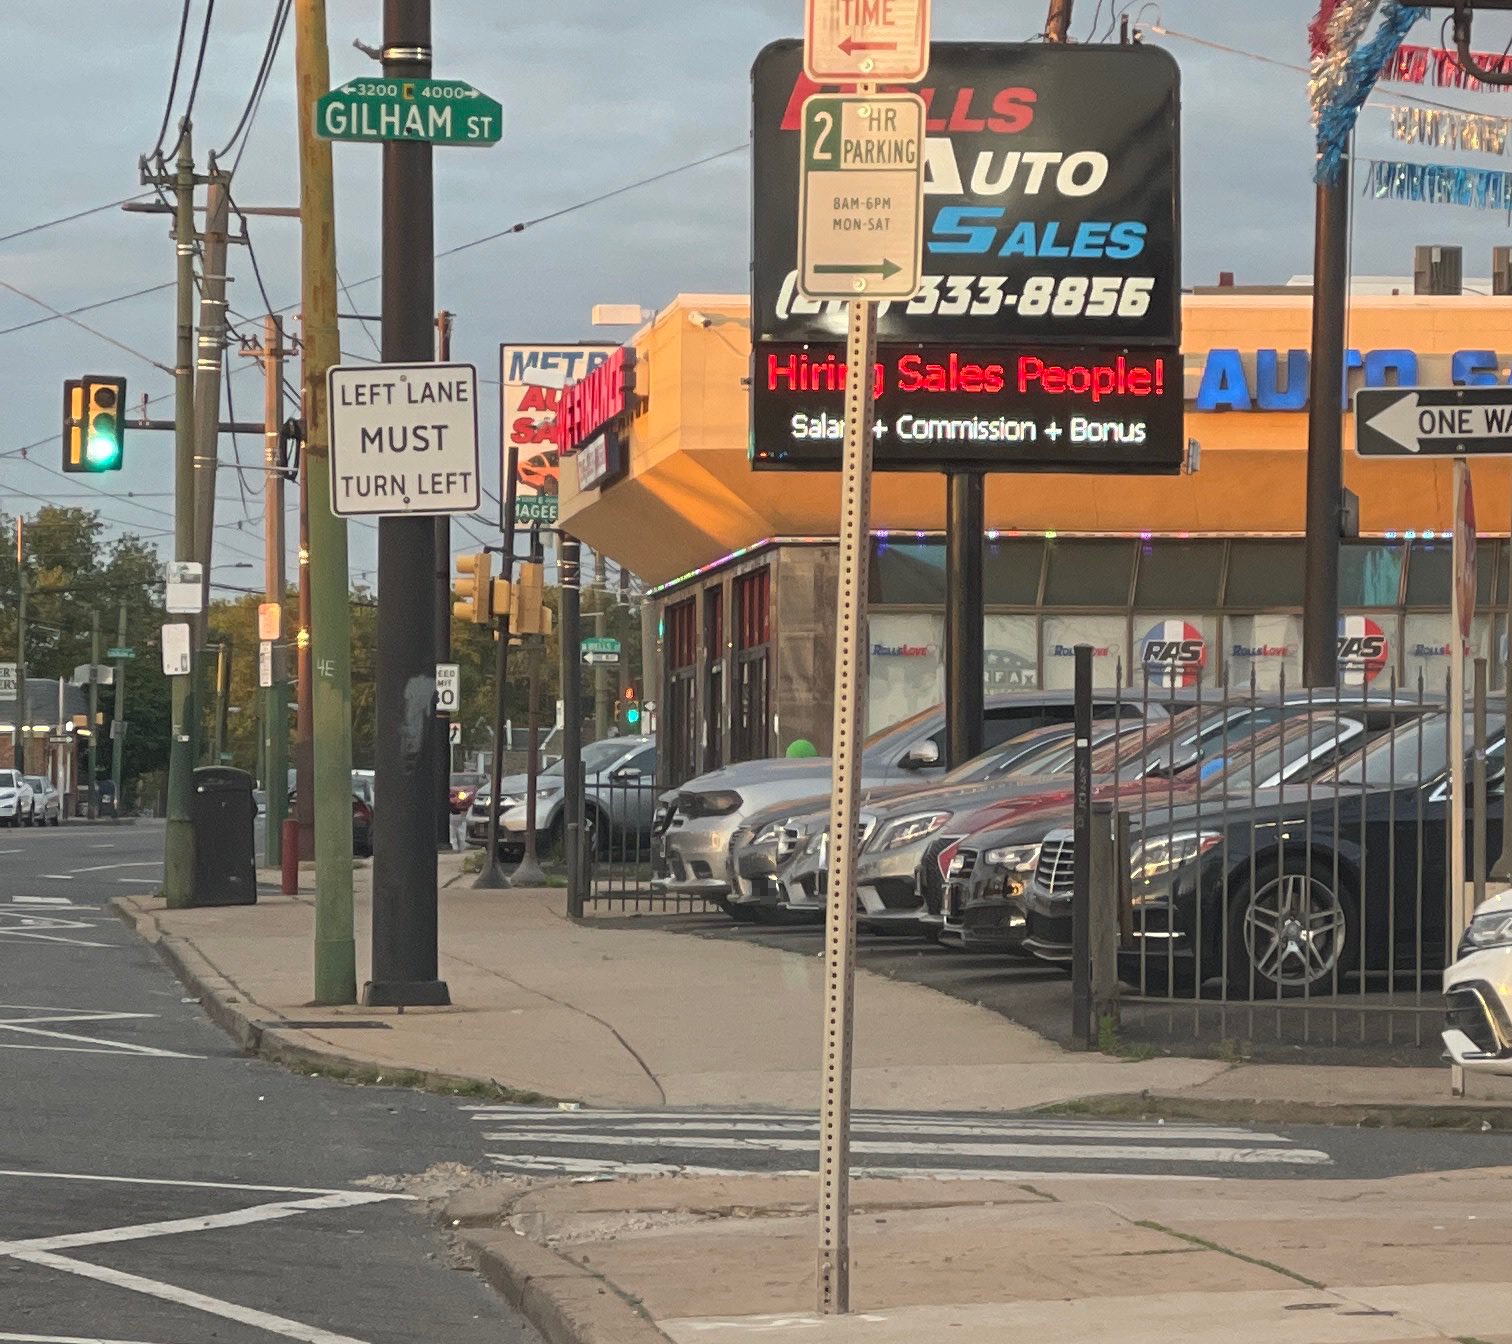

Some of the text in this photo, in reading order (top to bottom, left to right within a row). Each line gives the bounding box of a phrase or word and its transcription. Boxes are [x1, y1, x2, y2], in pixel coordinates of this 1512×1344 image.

[356, 83, 398, 97] 3200
[421, 86, 465, 99] 4000
[325, 101, 493, 138] GILHAM ST
[812, 107, 898, 160] 2 HR
[843, 138, 916, 164] PARKING
[833, 197, 891, 210] 8AM-6PM
[832, 217, 891, 231] MON-SAT
[927, 206, 1148, 260] SALES
[905, 275, 1156, 318] 333-8856
[898, 351, 1005, 394] Sales
[1017, 355, 1166, 403] People!
[341, 381, 469, 406] LEFT LANE
[791, 412, 846, 440] Salar
[896, 413, 1038, 443] Commission
[1070, 416, 1147, 444] Bonus
[1418, 409, 1473, 435] ONE
[360, 424, 449, 454] MUST
[340, 471, 472, 498] TURN LEFT
[515, 503, 557, 519] AGEE
[1142, 640, 1206, 662] RAS
[437, 669, 456, 678] EED
